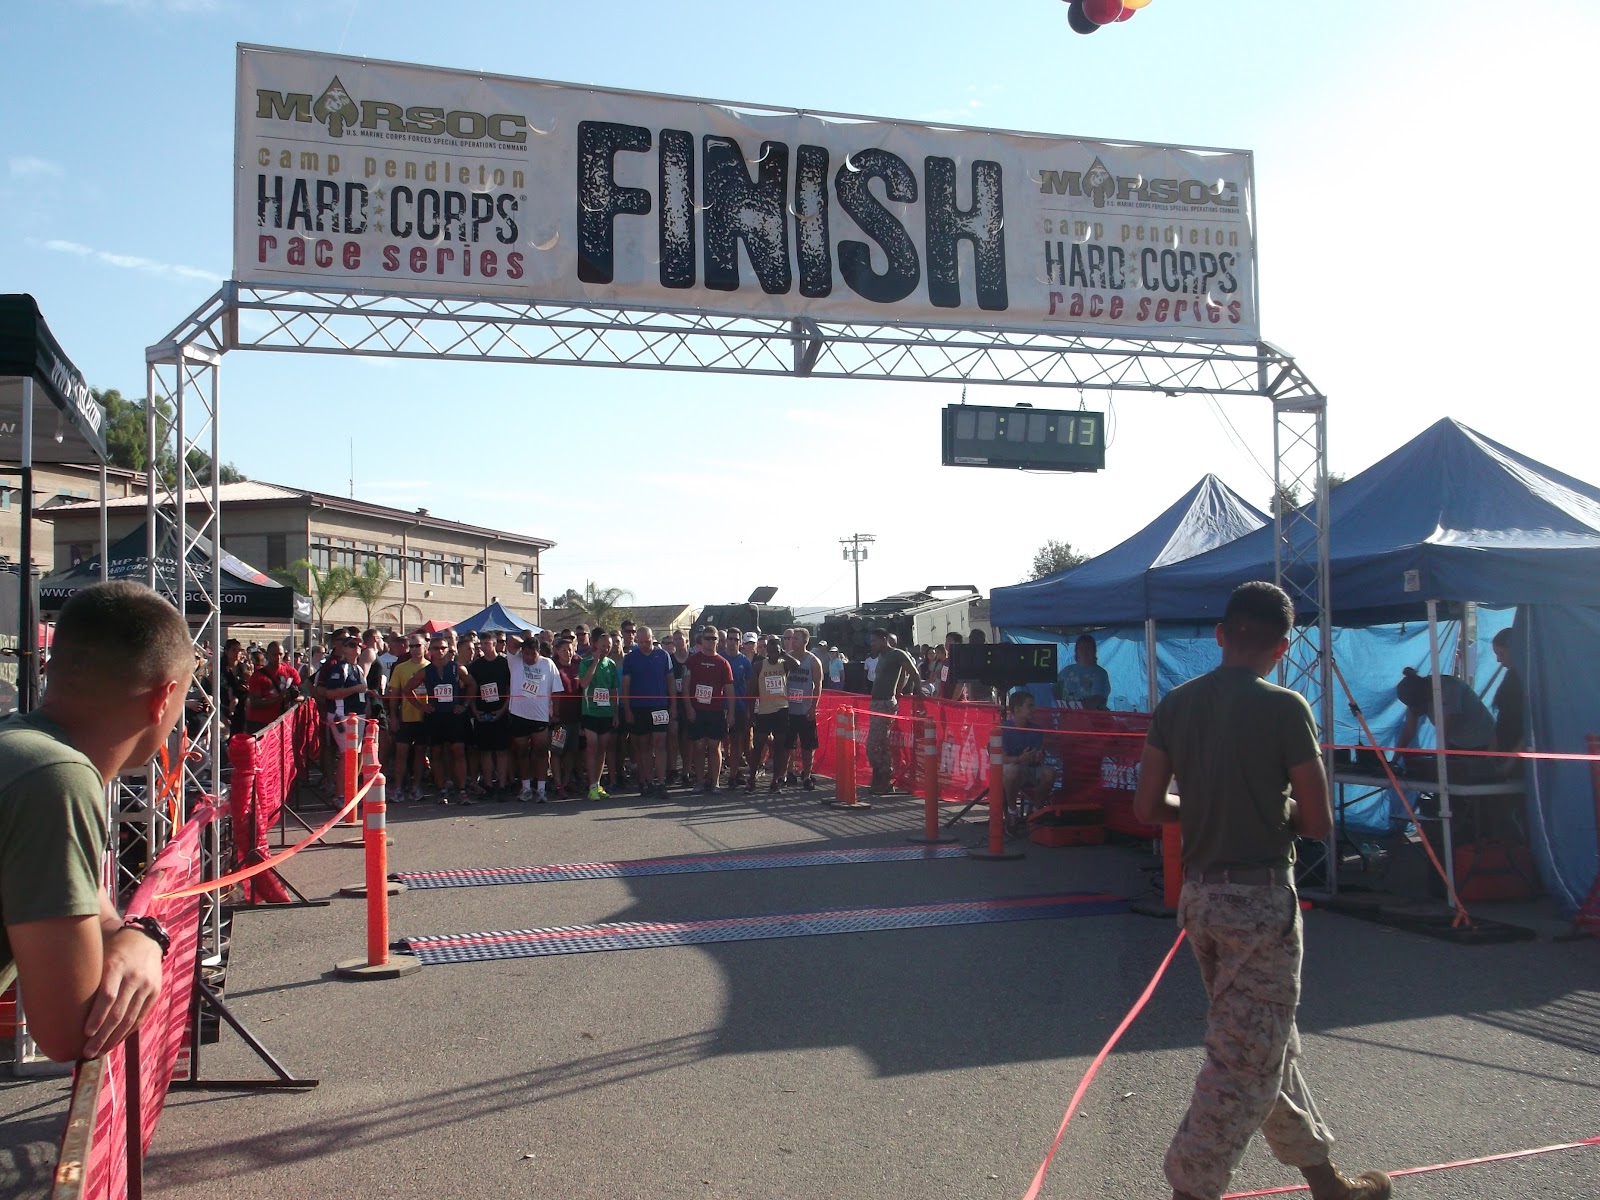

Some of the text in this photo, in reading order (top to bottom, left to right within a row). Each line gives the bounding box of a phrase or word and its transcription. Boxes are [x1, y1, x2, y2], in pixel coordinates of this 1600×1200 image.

[360, 130, 383, 139] MARINE
[386, 132, 406, 141] CORPS
[408, 135, 432, 144] FORCES
[434, 138, 458, 147] SPECIAL
[460, 141, 497, 149] OPERATIONS
[498, 143, 528, 152] COMMAND
[258, 148, 525, 189] camp pendleton
[257, 174, 368, 235] HARD
[577, 120, 1009, 311] FINISH
[1044, 218, 1239, 247] camp pendleton
[258, 235, 524, 279] race series
[1044, 240, 1126, 289] HARD
[1048, 291, 1241, 324] race series
